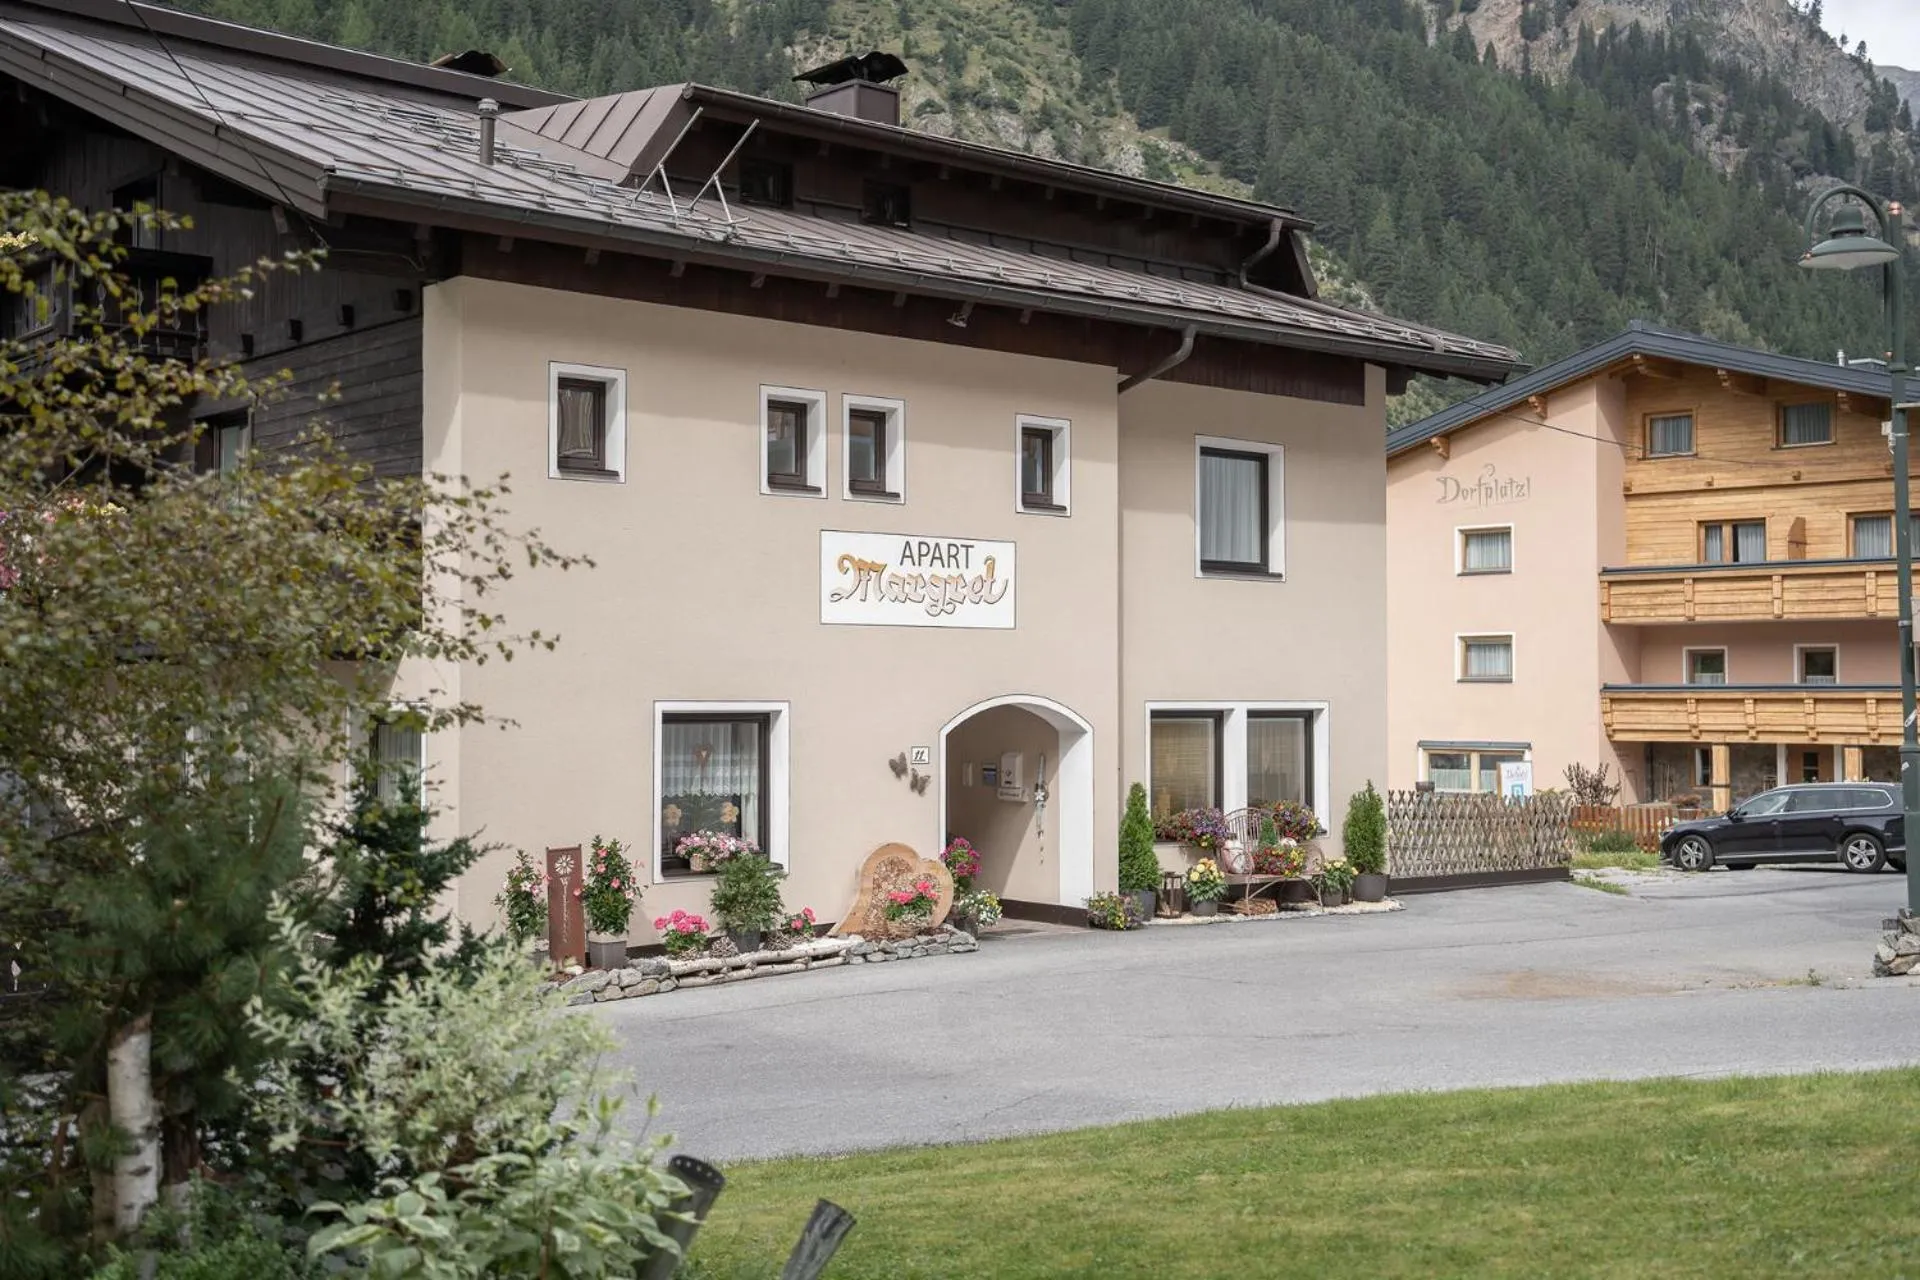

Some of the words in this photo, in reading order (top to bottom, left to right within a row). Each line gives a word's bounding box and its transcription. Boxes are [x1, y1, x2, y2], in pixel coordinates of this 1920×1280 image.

[1436, 473, 1531, 508] Dorfplatzl
[899, 540, 975, 569] APART
[829, 553, 1009, 617] Margret
